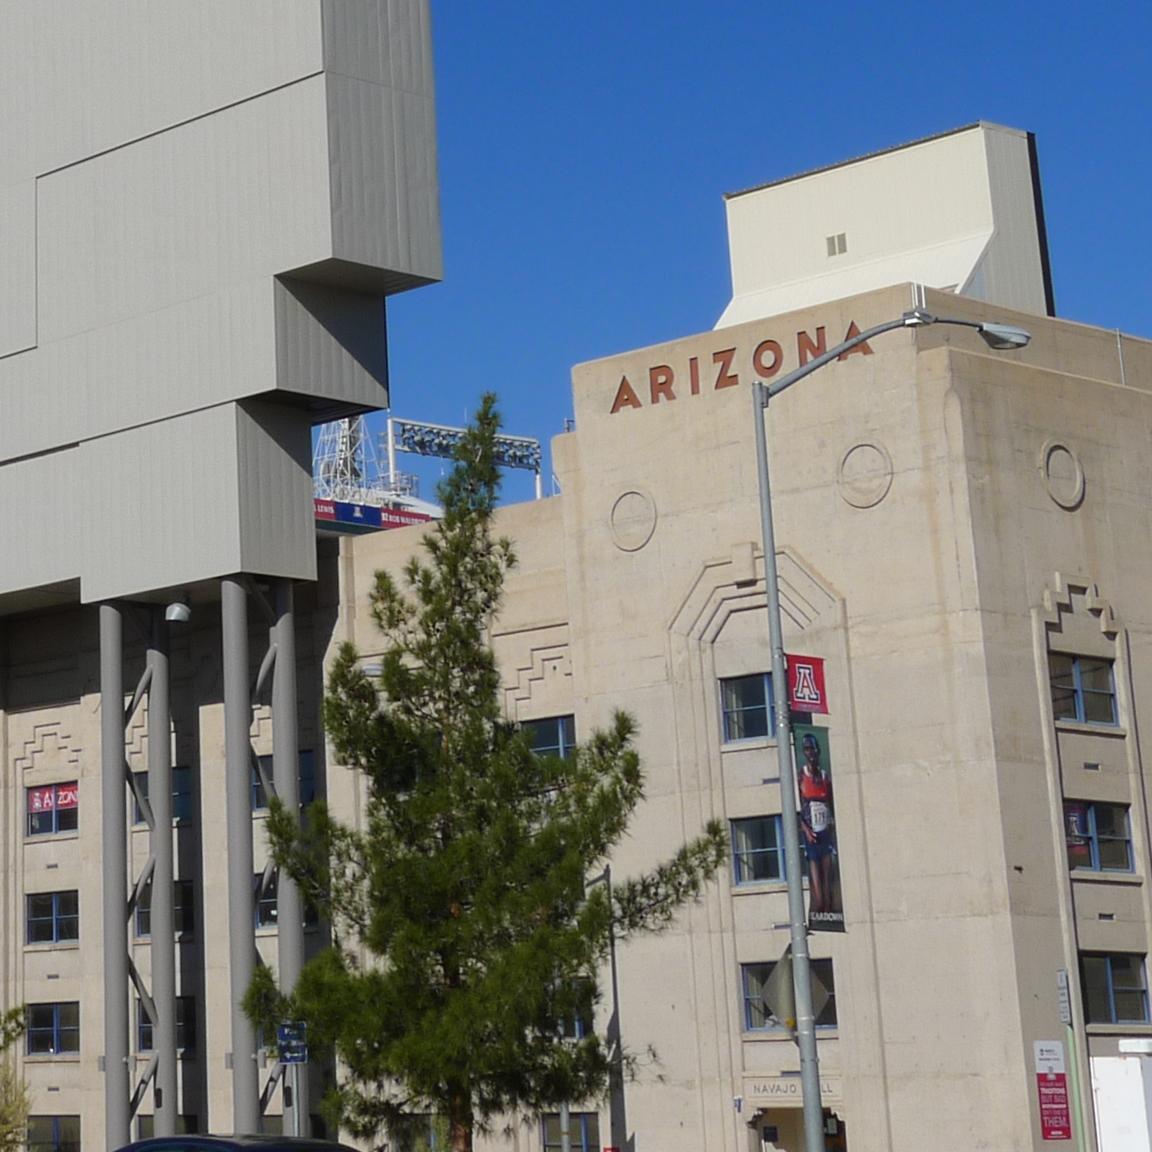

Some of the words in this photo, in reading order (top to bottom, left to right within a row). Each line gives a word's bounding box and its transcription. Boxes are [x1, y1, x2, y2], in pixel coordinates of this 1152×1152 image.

[609, 320, 875, 414] ARIZONA
[793, 664, 820, 703] A
[753, 1083, 797, 1094] NAVAJO
